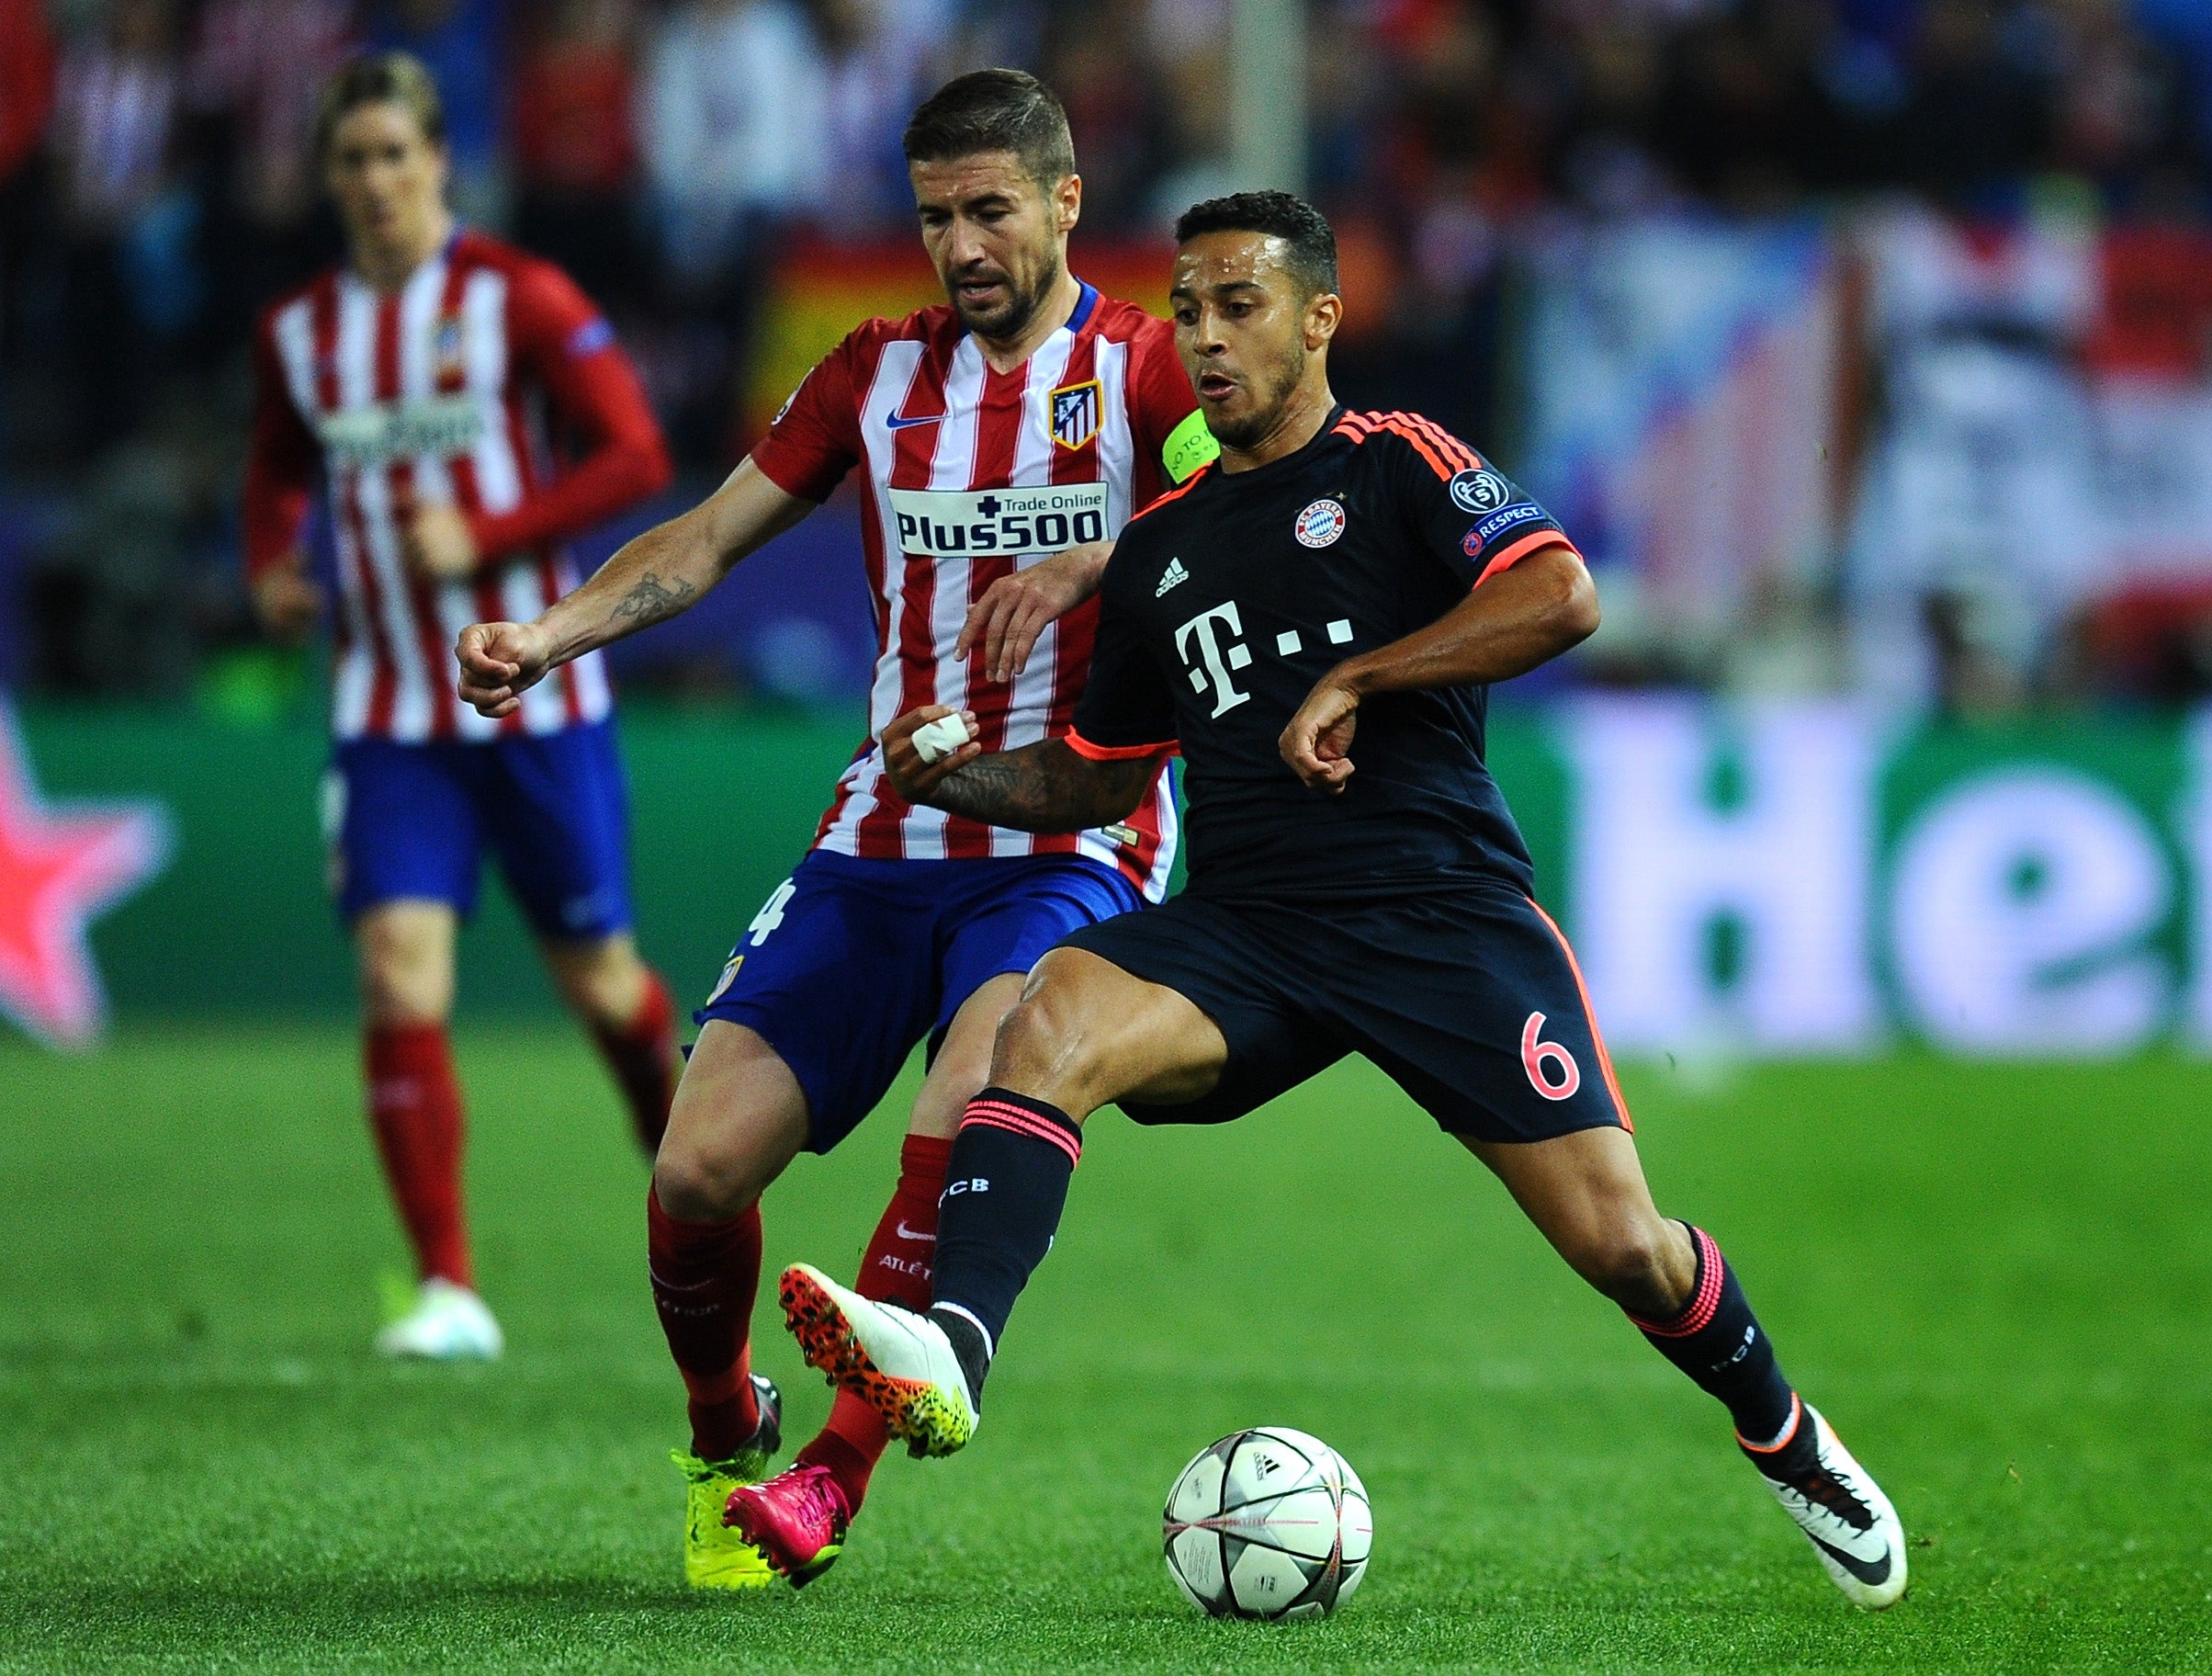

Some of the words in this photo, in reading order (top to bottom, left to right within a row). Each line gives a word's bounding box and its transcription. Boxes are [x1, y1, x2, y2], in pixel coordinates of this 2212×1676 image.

[1183, 435, 1201, 450] TO
[1004, 496, 1046, 512] Trade
[1052, 493, 1102, 510] Online
[1307, 503, 1341, 517] BAYERN
[1474, 488, 1491, 502] 5
[897, 509, 1102, 551] Plus500
[1479, 506, 1541, 538] RESPECT
[1156, 570, 1190, 598] adidas
[1174, 599, 1253, 720] T
[1566, 708, 2212, 1057] He
[1520, 1011, 1581, 1101] 6
